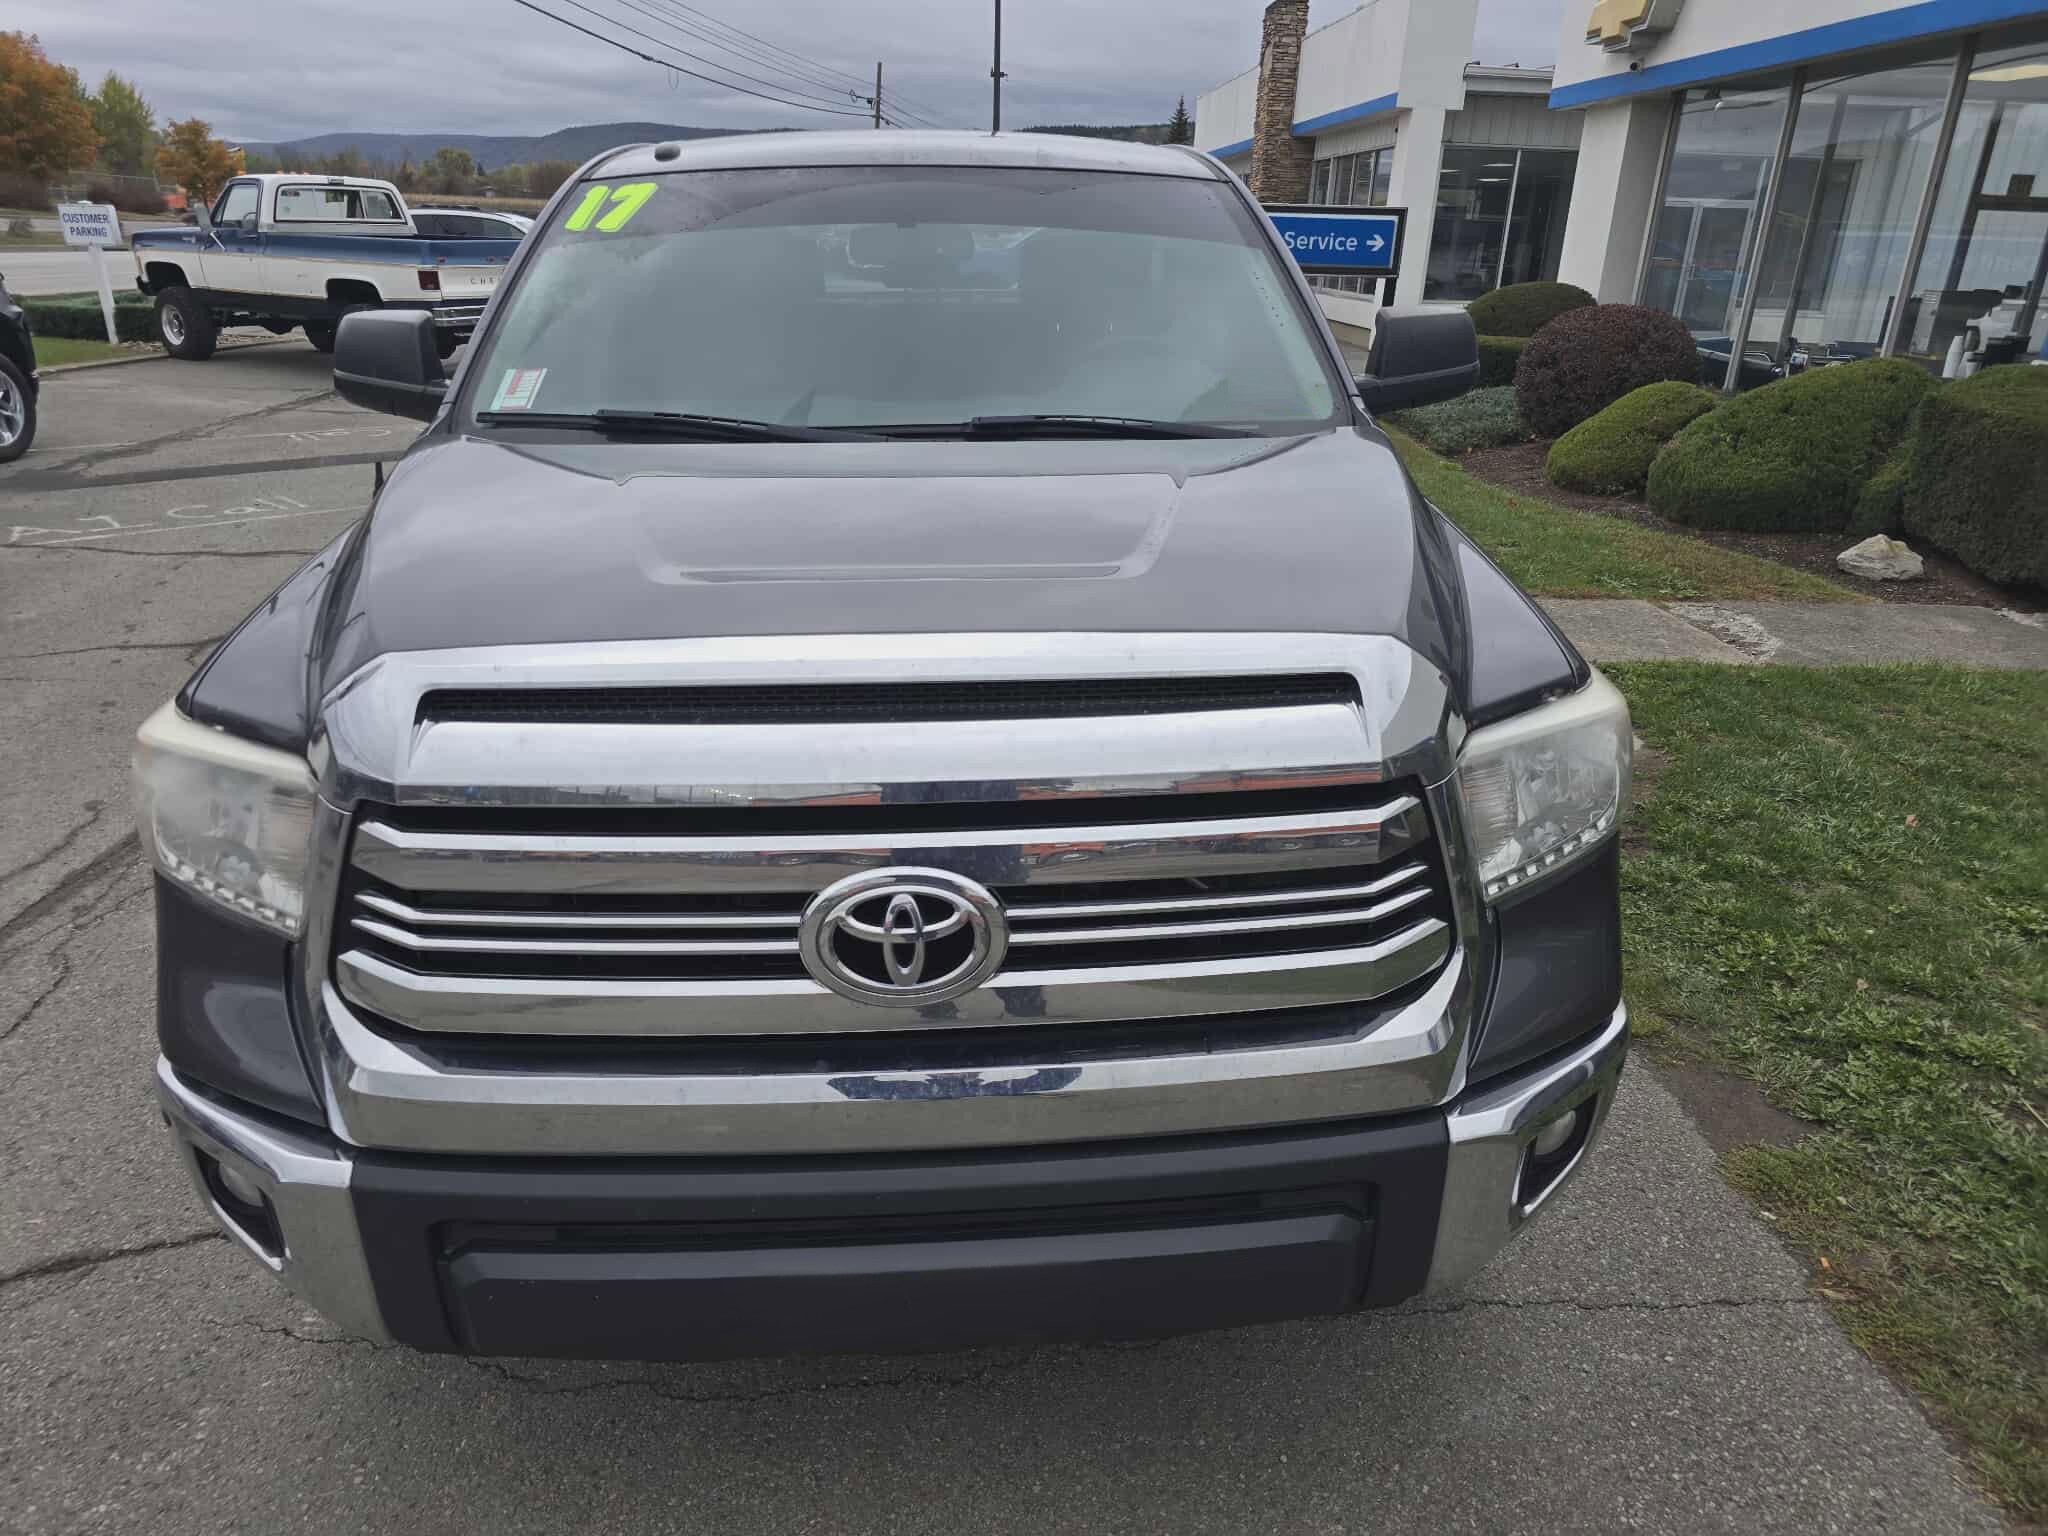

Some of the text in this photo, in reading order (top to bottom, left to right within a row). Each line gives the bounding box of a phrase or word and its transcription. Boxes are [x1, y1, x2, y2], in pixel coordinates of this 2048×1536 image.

[564, 182, 658, 233] 17
[63, 212, 110, 224] CUSTOMER
[70, 226, 108, 238] PARKING
[1283, 231, 1358, 251] Service
